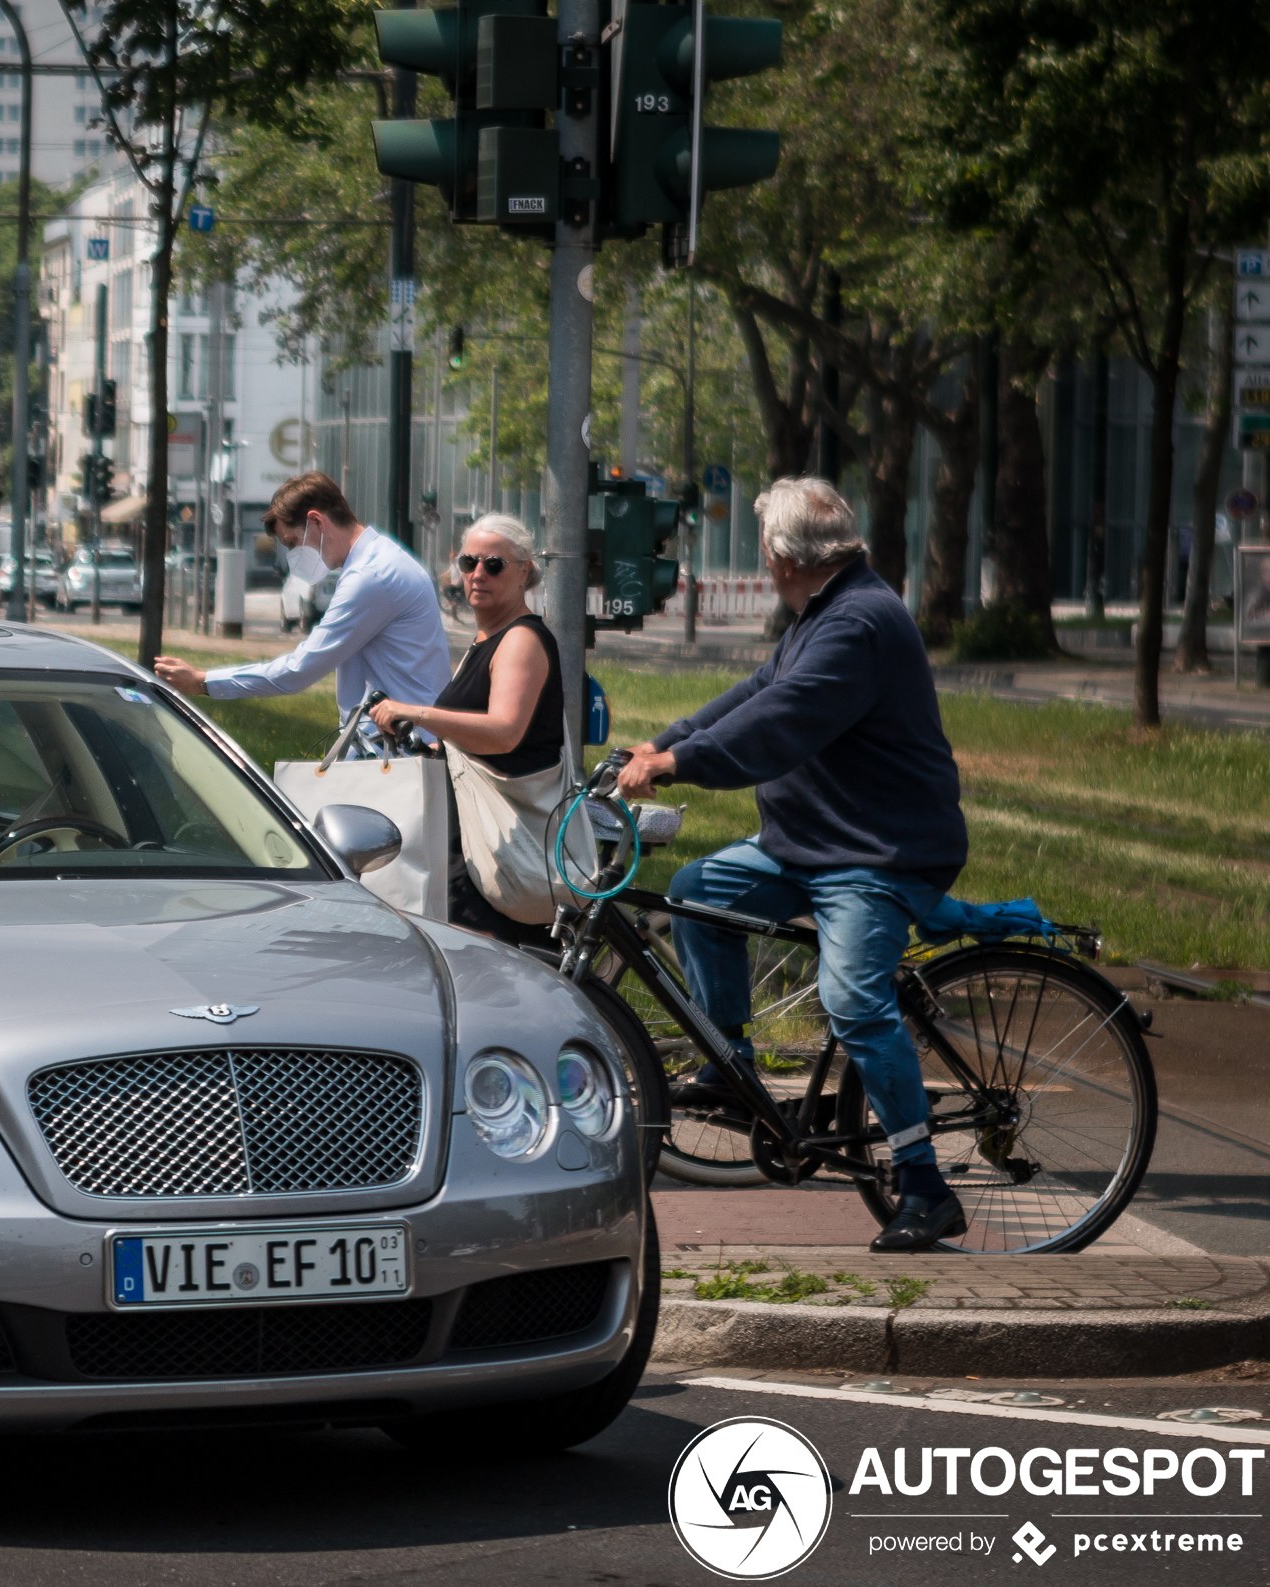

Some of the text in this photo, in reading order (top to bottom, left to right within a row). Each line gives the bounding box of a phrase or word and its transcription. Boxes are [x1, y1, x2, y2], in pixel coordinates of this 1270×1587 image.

[634, 94, 669, 113] 193
[192, 209, 211, 228] T
[89, 242, 108, 258] W
[604, 598, 634, 616] 195
[380, 1238, 399, 1250] 03
[145, 1236, 377, 1293] VIE EF 10
[123, 1277, 135, 1292] D
